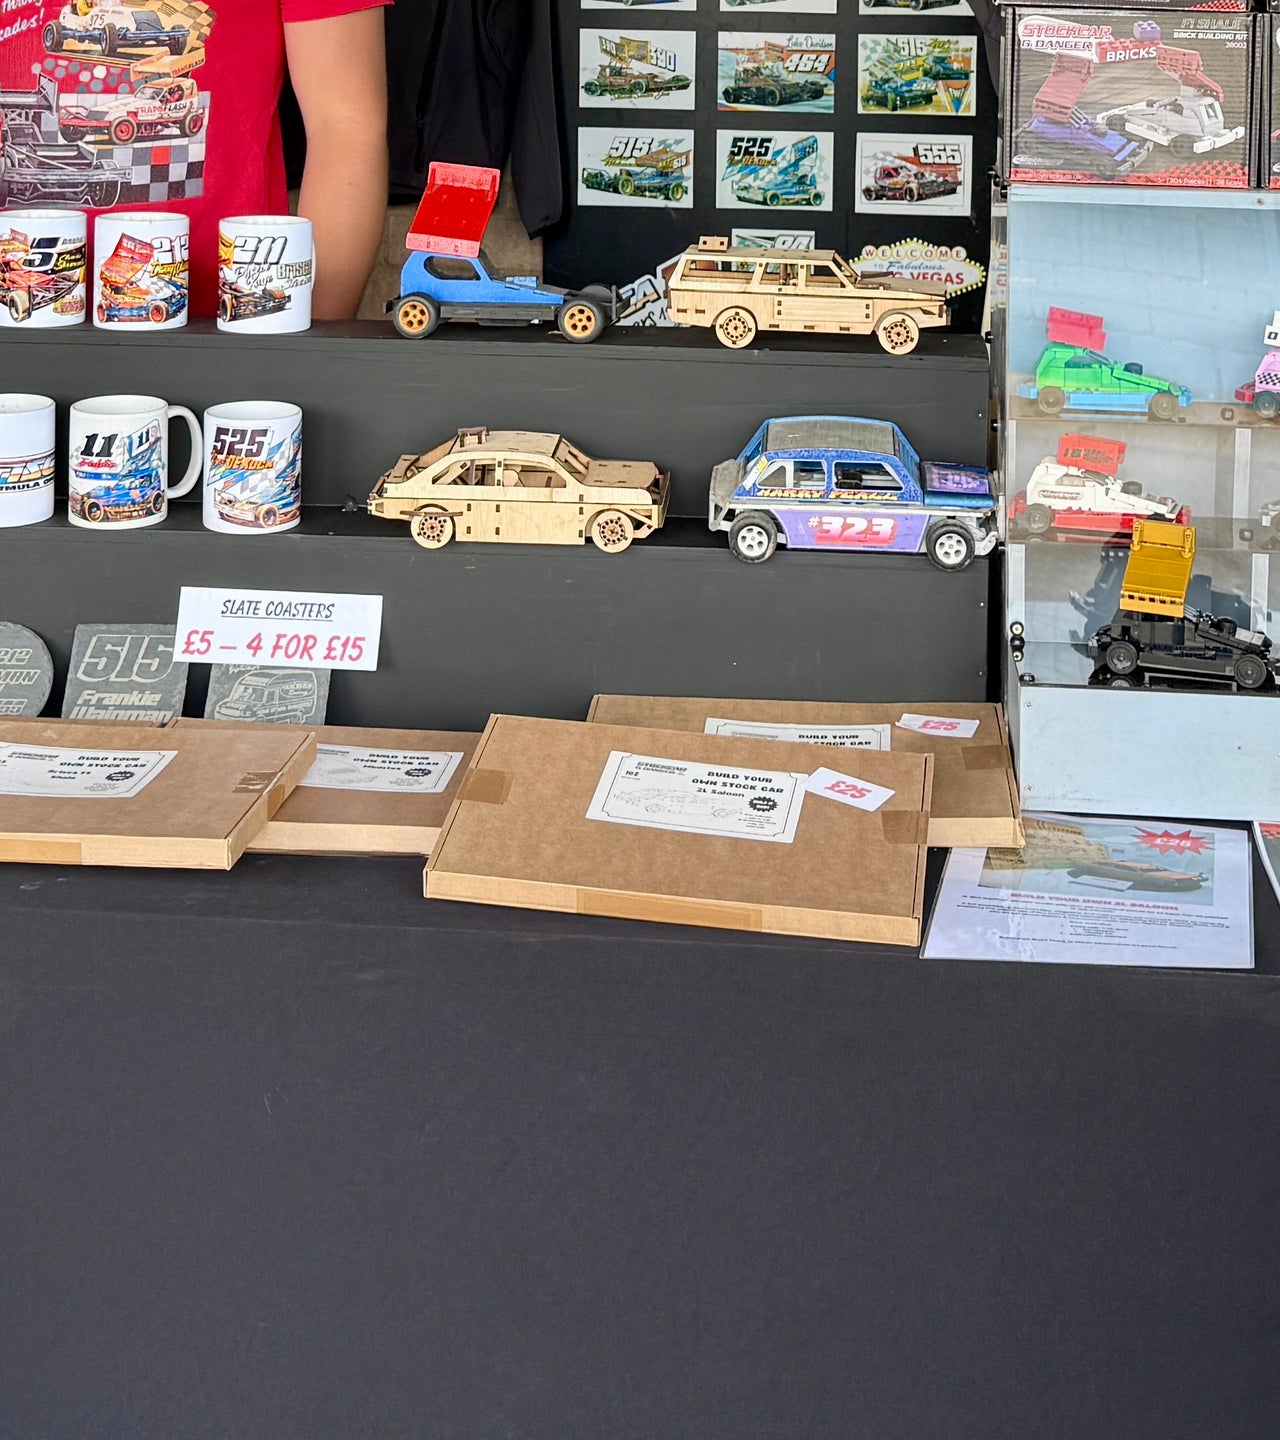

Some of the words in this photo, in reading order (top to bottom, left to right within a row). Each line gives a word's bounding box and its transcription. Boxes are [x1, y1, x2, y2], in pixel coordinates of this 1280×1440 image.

[1021, 24, 1112, 39] STOCKCAR
[1173, 32, 1197, 40] BRICK
[1198, 32, 1234, 40] BUILDING
[1033, 40, 1093, 51] BANGER
[1107, 47, 1157, 62] BRICKS
[730, 136, 772, 157] 525
[918, 145, 964, 165] 555
[865, 246, 963, 259] WELCOME
[885, 260, 945, 271] Fabulous
[910, 271, 965, 286] VEGAS
[79, 432, 119, 458] 11
[213, 427, 268, 457] 525
[807, 514, 896, 542] #323
[221, 599, 262, 617] SLATE
[265, 601, 335, 619] COASTERS
[181, 629, 215, 656] £5
[246, 632, 263, 658] 4
[270, 632, 318, 662] FOR
[322, 636, 366, 662] £15
[76, 633, 174, 684] 515
[76, 690, 163, 706] Frankie
[917, 719, 962, 732] £25
[707, 771, 741, 782] BUILD
[743, 773, 774, 784] YOUR
[691, 777, 720, 788] OWN
[721, 779, 760, 791] STOCK
[761, 784, 785, 795] CAR
[710, 787, 746, 798] Saloon
[823, 779, 874, 800] £25
